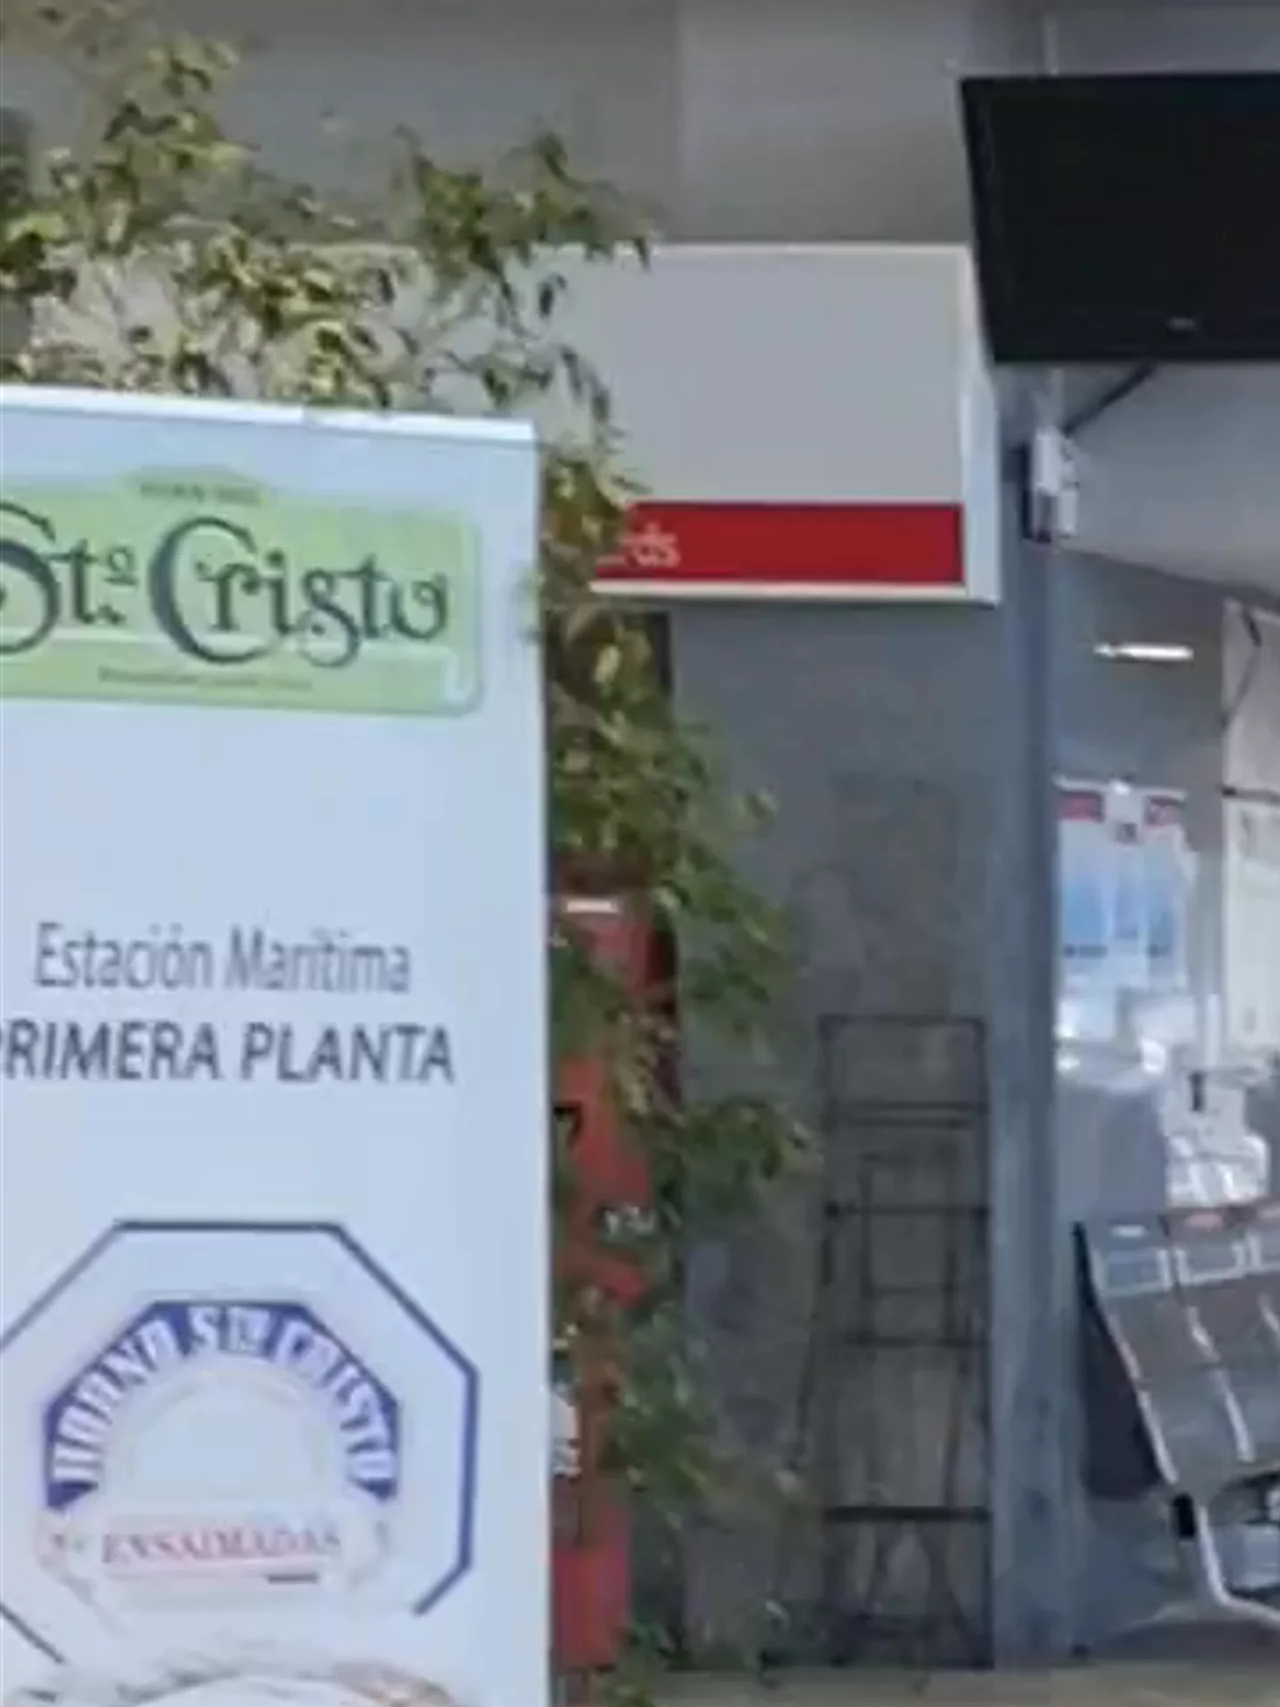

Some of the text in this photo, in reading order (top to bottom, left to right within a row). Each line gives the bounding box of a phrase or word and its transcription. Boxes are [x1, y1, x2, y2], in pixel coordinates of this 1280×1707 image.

[149, 515, 449, 668] Cristo
[34, 921, 215, 990] Estación
[240, 1022, 456, 1086] PLANTA
